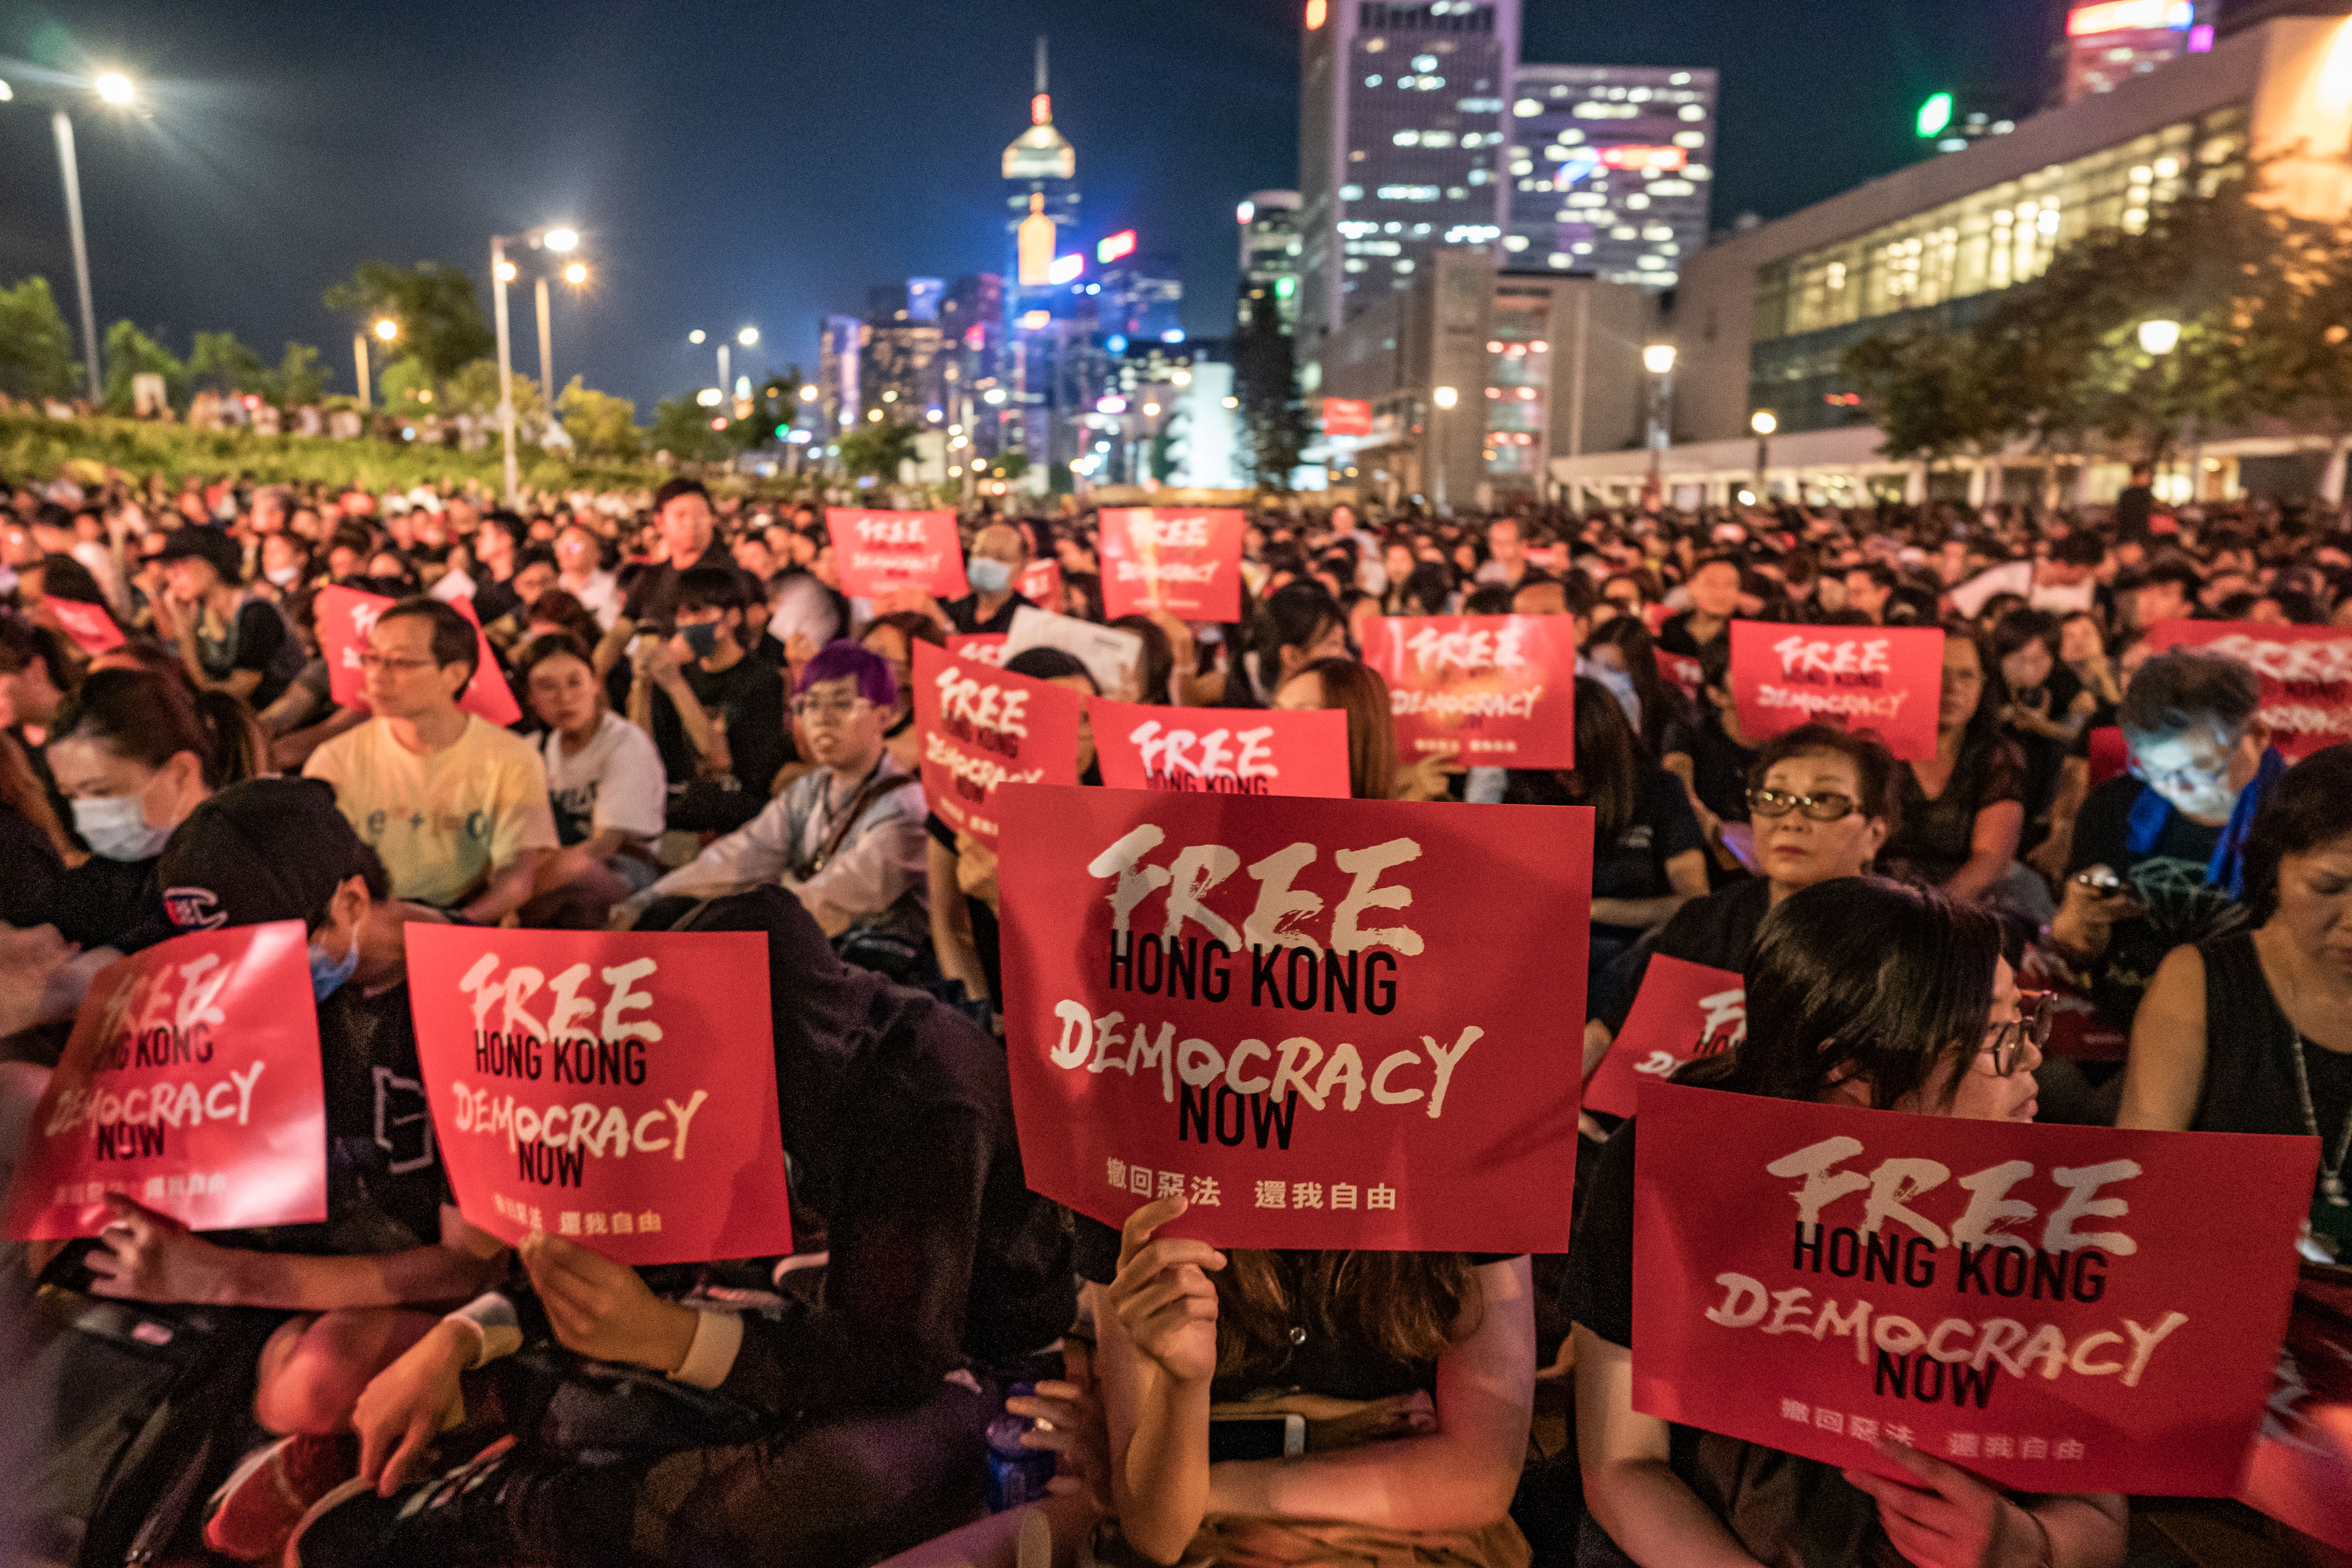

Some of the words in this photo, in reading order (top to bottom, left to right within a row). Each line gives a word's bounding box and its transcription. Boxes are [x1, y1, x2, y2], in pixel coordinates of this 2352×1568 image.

[1406, 627, 1525, 674] FREE
[1772, 636, 1890, 675] FREE
[936, 667, 1029, 738] FREE
[1129, 720, 1278, 780] FREE
[1088, 824, 1424, 962] FREE
[459, 953, 663, 1048] FREE
[1110, 929, 1231, 1003] HONG
[1251, 942, 1397, 1015] KONG
[135, 1022, 213, 1068] KONG
[475, 1029, 542, 1080] HONG
[554, 1036, 646, 1085] KONG
[1051, 999, 1484, 1118] DEMOCRACY
[98, 1117, 165, 1161] NOW
[453, 1081, 708, 1161] DEMOCRACY
[1179, 1082, 1298, 1150] NOW
[519, 1138, 585, 1188] NOW
[1255, 1179, 1395, 1210] 還我自由
[1767, 1136, 2141, 1258] FREE
[1793, 1221, 1936, 1288] HONG
[1957, 1241, 2109, 1303] KONG
[1705, 1272, 2189, 1388] DEMOCRACY
[1876, 1349, 1996, 1409] NOW
